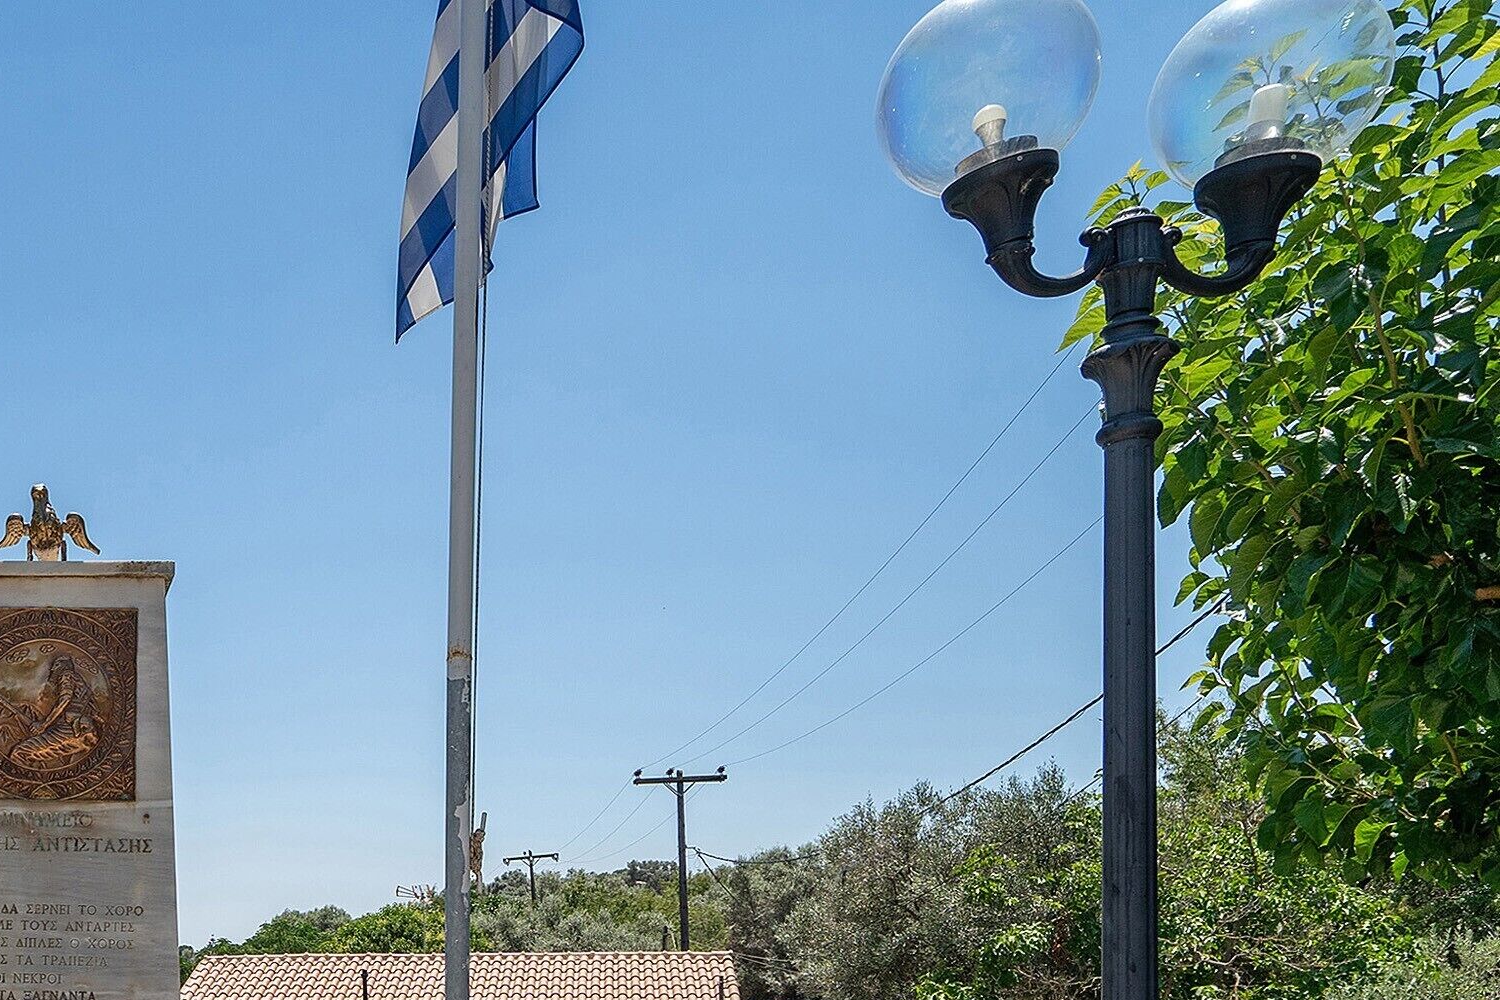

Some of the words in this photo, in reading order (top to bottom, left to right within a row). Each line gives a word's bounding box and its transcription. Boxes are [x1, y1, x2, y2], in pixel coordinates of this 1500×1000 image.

[33, 836, 154, 854] ΑΝΤΙΣΤΑΣΗΣ
[26, 903, 71, 915] ΣΕΡΝΕΙ
[78, 904, 97, 916] ΤΟ
[105, 905, 144, 917] ΧΟΡΟ
[21, 919, 58, 931] ΤΟΥΣ
[15, 936, 63, 948] ΔΙΠΛΕΣ
[70, 938, 80, 949] Ο
[87, 938, 135, 950] ΧΟΡΟΣ
[16, 954, 34, 966] ΤΑ
[12, 972, 62, 984] ΝΕΚΡΟΙ
